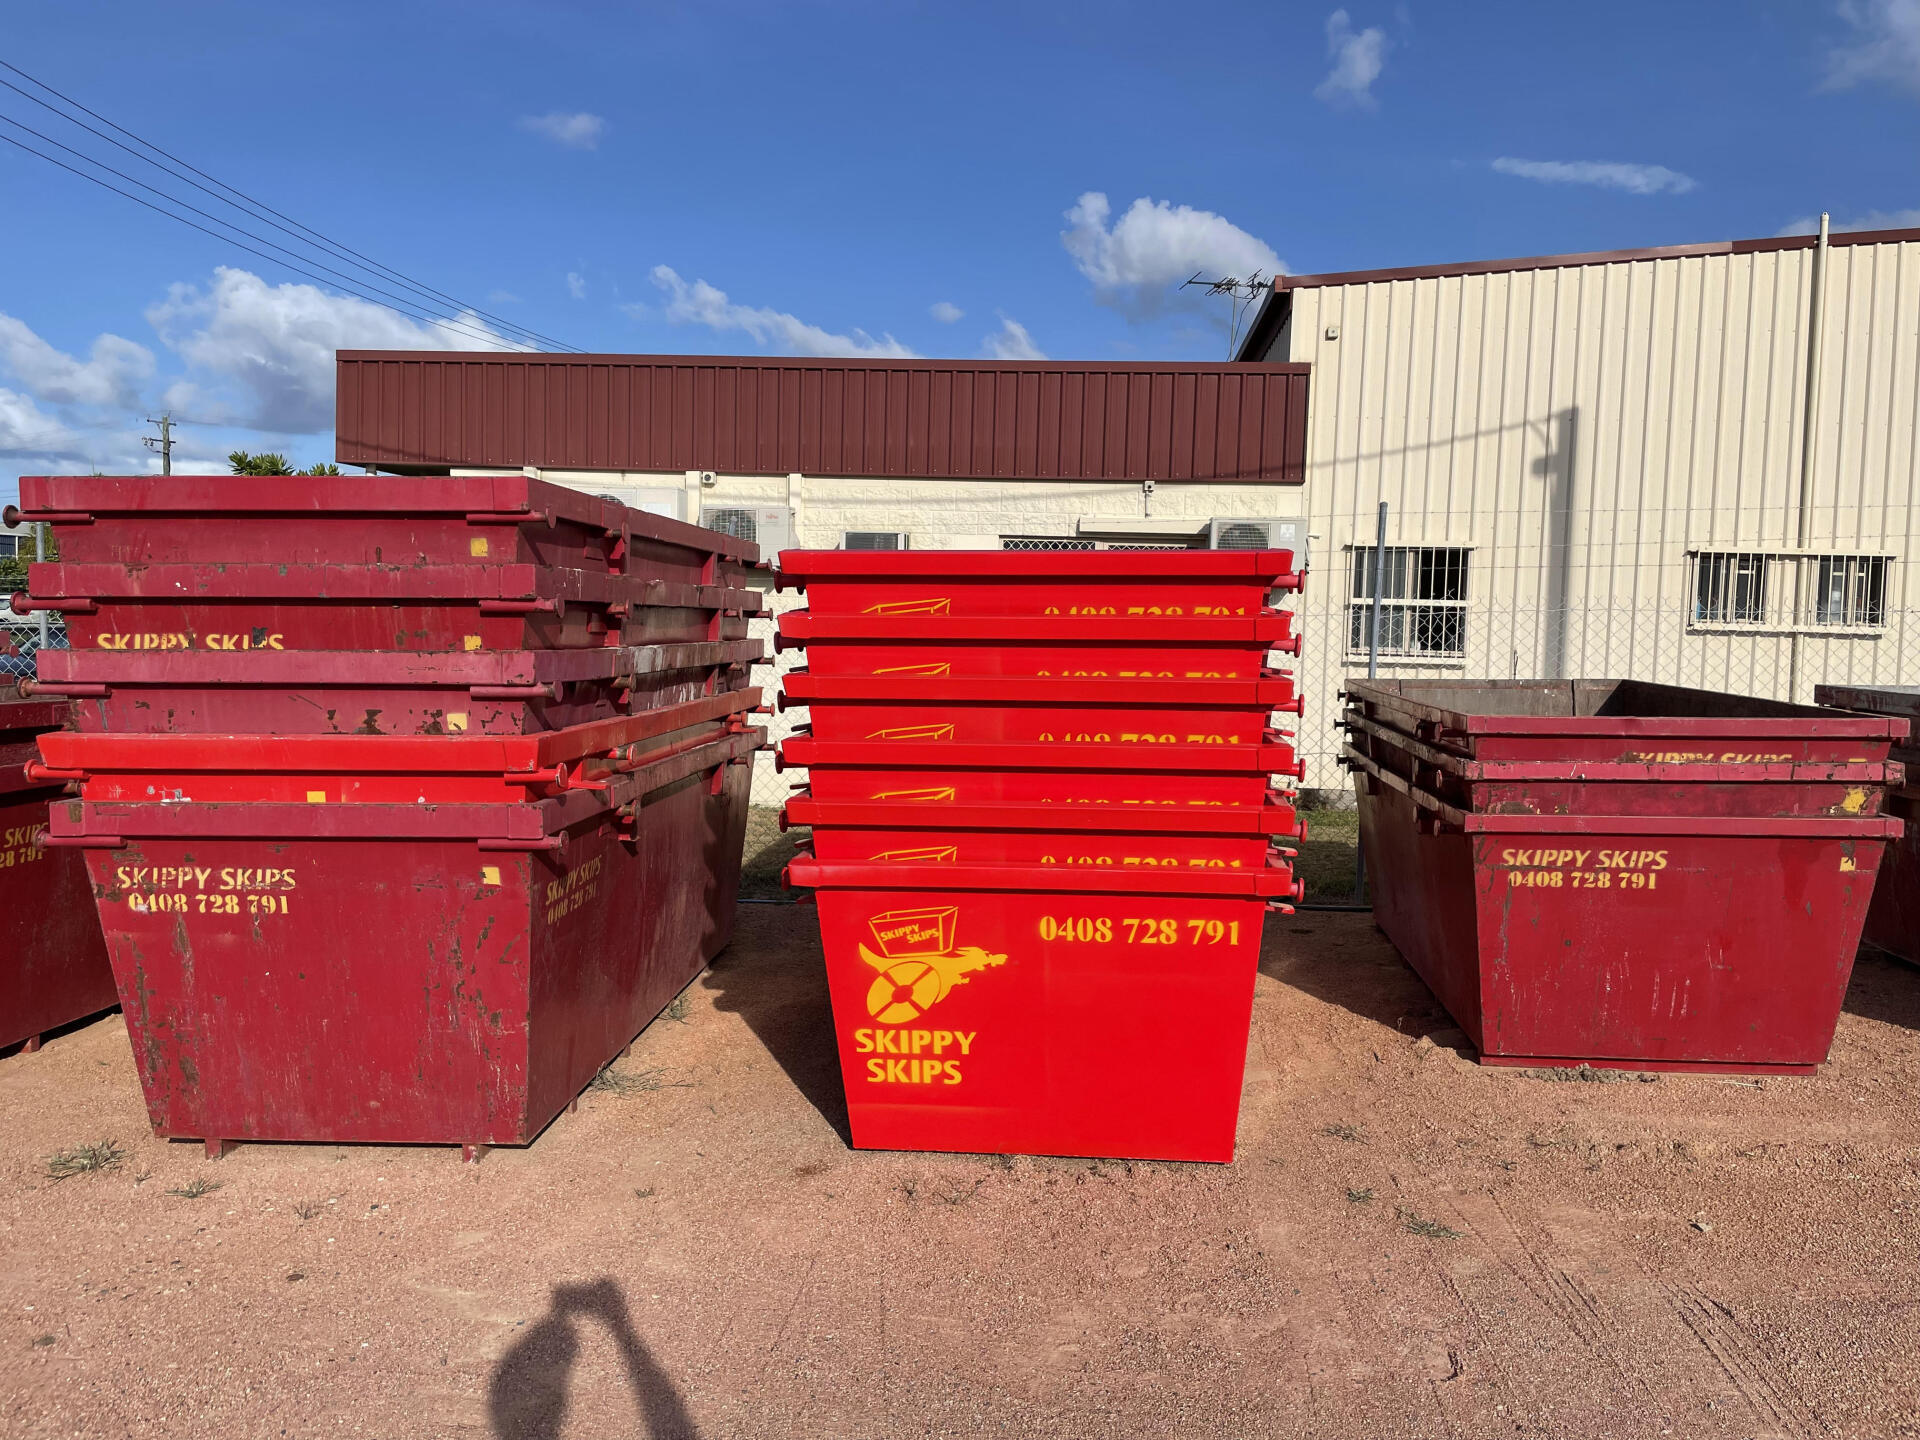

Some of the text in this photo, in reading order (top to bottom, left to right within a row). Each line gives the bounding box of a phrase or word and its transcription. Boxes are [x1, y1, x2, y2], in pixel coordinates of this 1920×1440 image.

[1501, 848, 1669, 870] SKIPPY SKIPS
[116, 865, 296, 891] SKIPPY SKIPS
[1507, 871, 1657, 890] 0408 728 791
[128, 892, 289, 914] 0408 728 791
[880, 923, 920, 942] SKIPPY
[907, 927, 940, 944] SKIPS
[1039, 915, 1240, 946] 0408 728 791
[854, 1028, 977, 1055] SKIPPY
[866, 1058, 963, 1085] SKIPS
